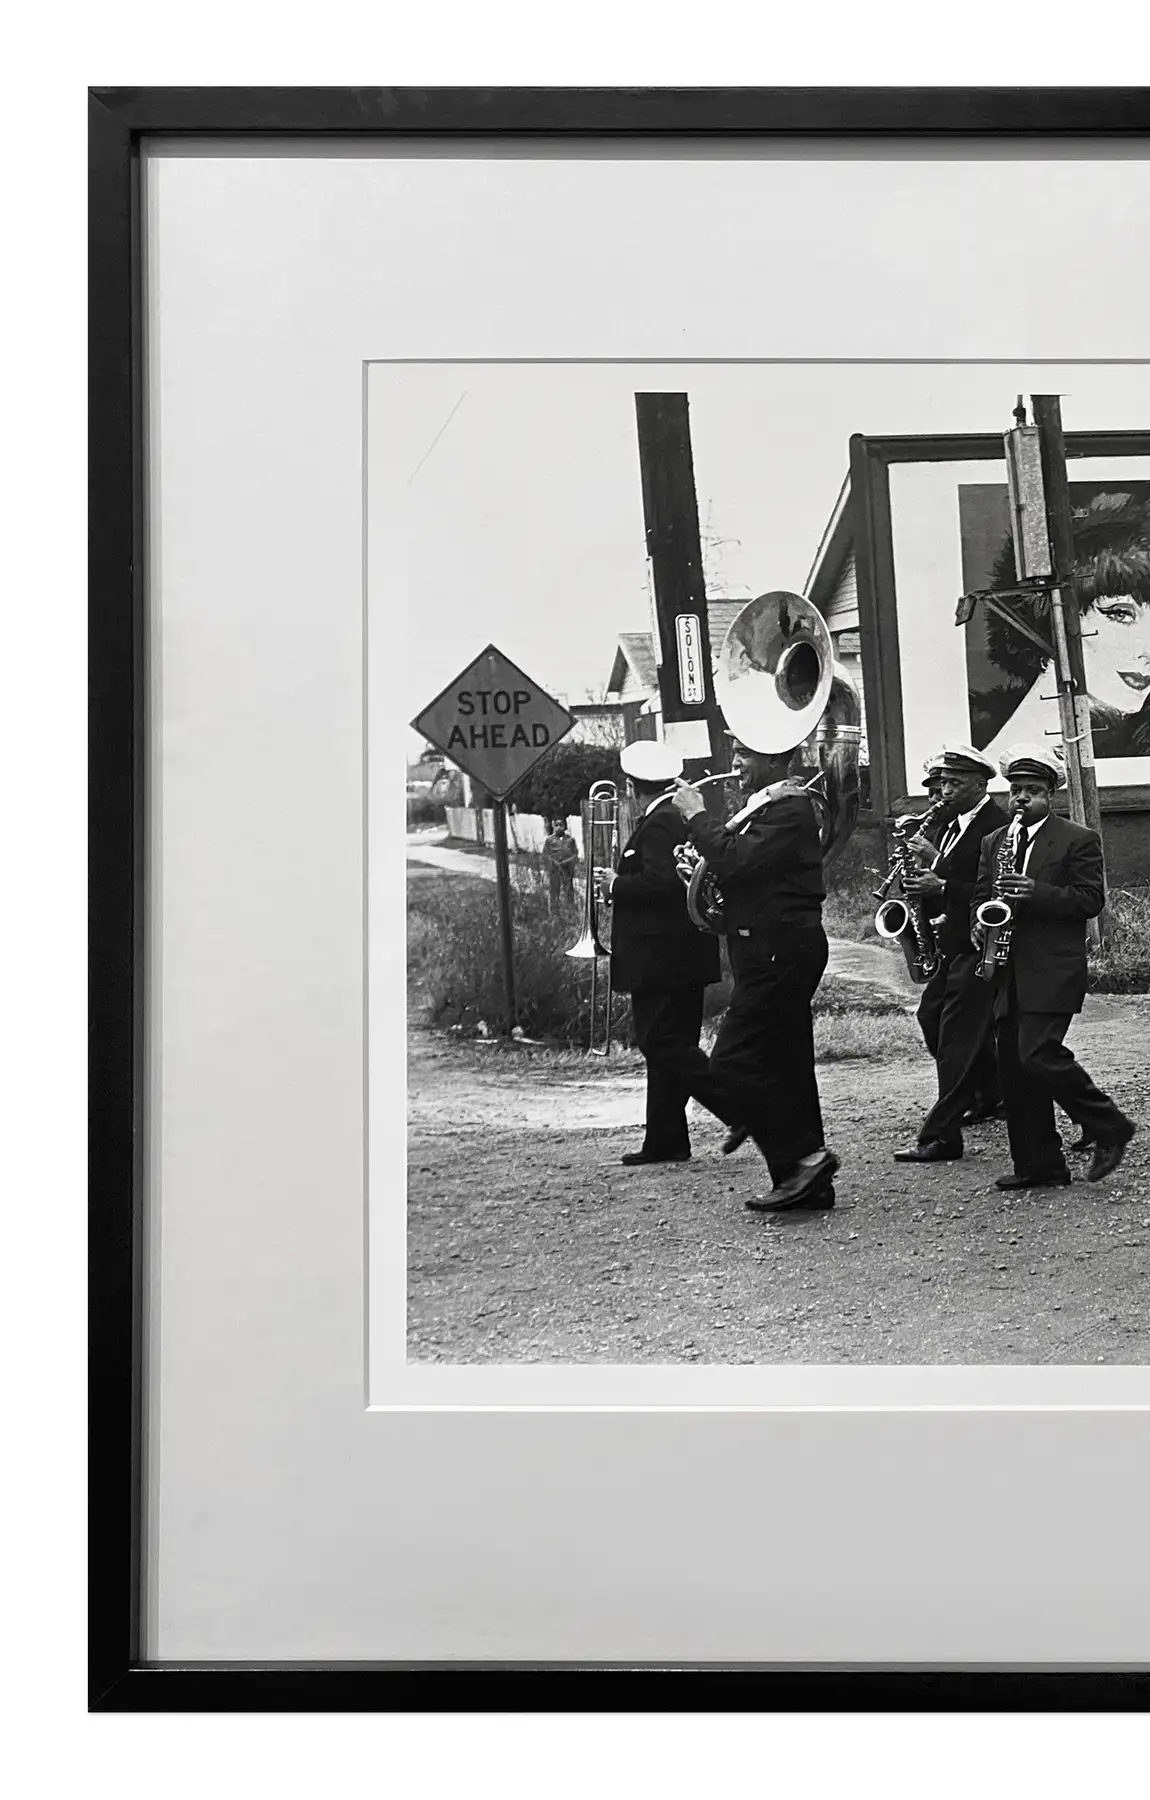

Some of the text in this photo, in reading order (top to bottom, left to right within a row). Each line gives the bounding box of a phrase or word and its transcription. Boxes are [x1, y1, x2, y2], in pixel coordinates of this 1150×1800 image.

[684, 620, 696, 685] SOLON
[458, 690, 532, 715] STOP
[447, 723, 550, 749] AHEAD
